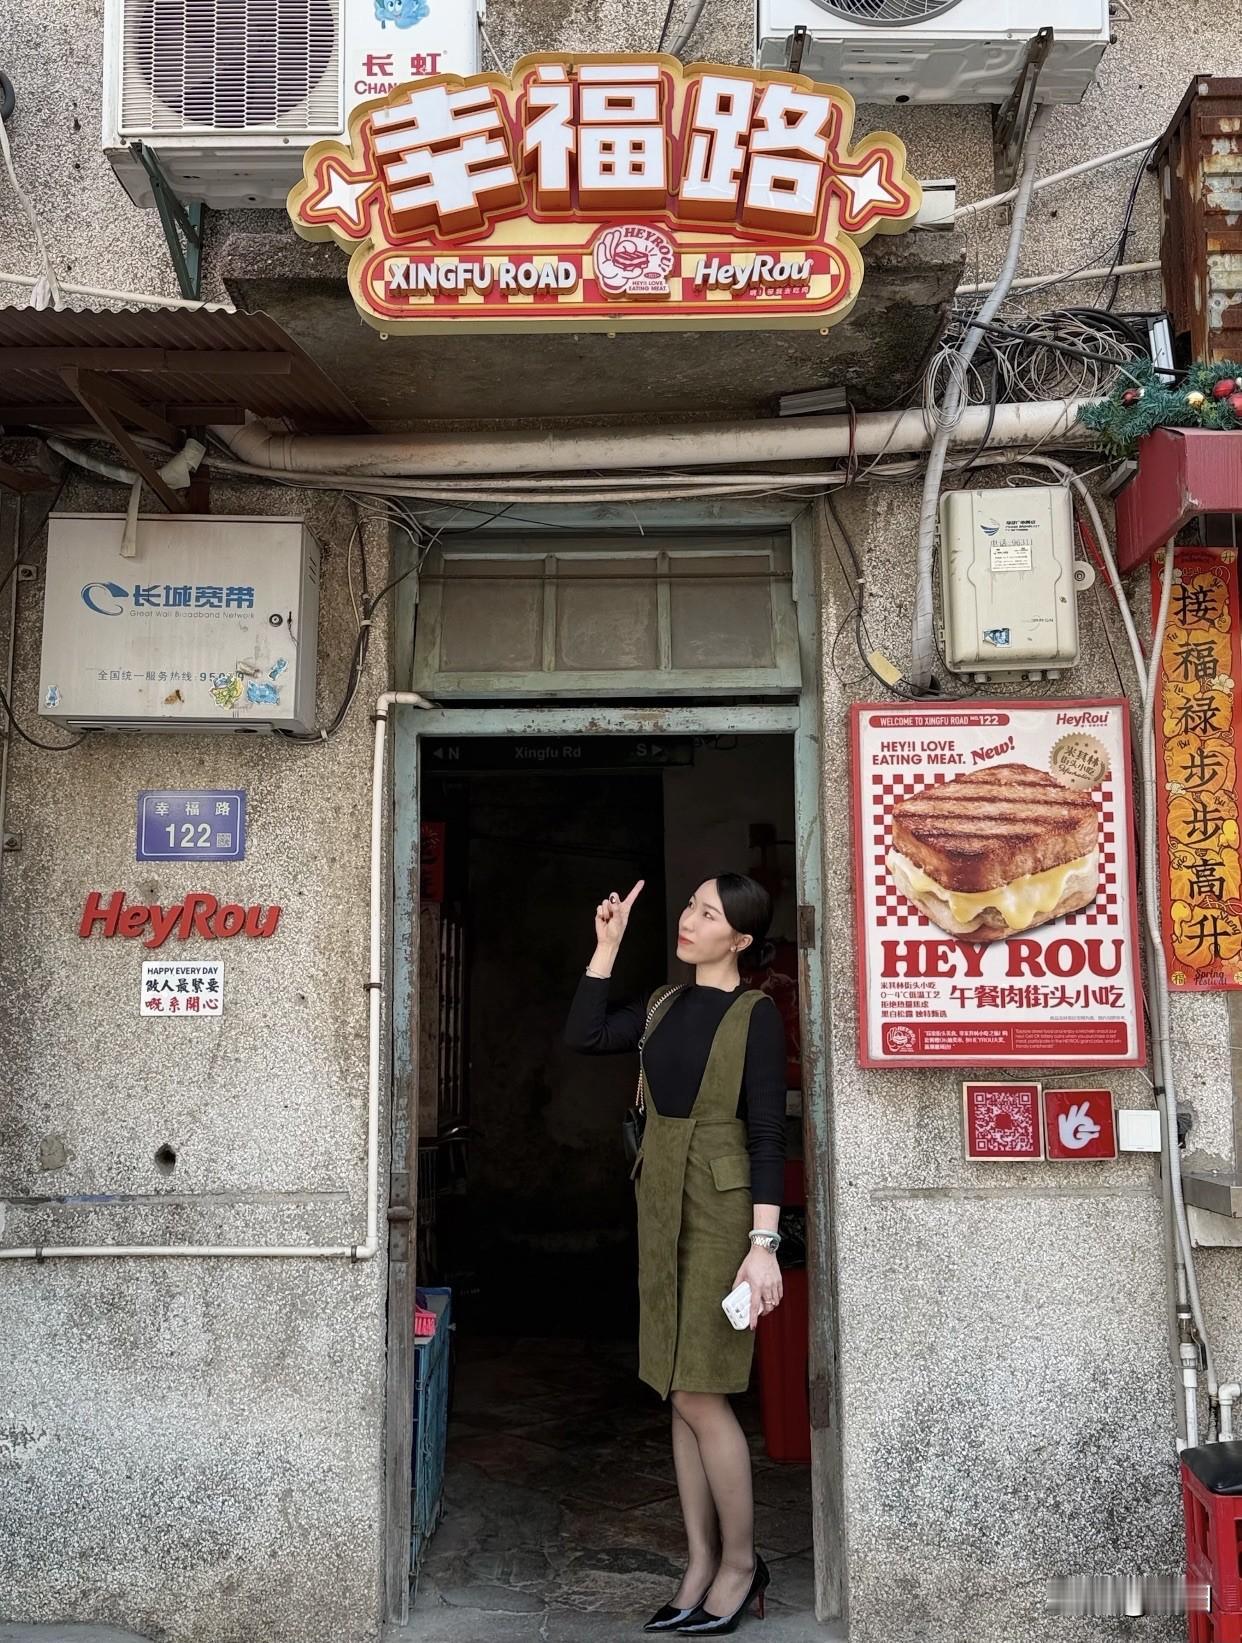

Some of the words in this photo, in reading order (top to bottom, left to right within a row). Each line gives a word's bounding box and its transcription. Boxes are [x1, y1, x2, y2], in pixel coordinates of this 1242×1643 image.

[362, 53, 441, 76] 长虹
[367, 63, 834, 228] 幸福路
[389, 262, 494, 294] XINGFU
[500, 262, 579, 294] ROAD
[694, 255, 814, 291] HeyRou
[133, 585, 255, 609] 长城宽带
[155, 610, 171, 618] Wall
[174, 611, 220, 619] Broadband
[222, 611, 255, 619] Network
[98, 669, 193, 682] 全国统一服务热线
[880, 717, 913, 727] WELCOME
[915, 717, 923, 726] TO
[924, 716, 949, 726] XINGFU
[950, 716, 969, 725] ROAD
[1056, 711, 1109, 727] HeyRou
[514, 745, 559, 761] Xingfu
[562, 745, 582, 759] Rd
[636, 743, 648, 757] S
[920, 740, 956, 752] LOVE
[970, 735, 1016, 766] New!
[872, 754, 923, 766] EATING
[926, 753, 966, 765] MEAT.
[155, 801, 231, 817] 幸福路
[165, 823, 212, 848] 122
[79, 891, 281, 949] HeyRou
[880, 939, 992, 978] HEY
[1005, 938, 1125, 978] ROU
[147, 966, 174, 975] HAPPY
[175, 966, 201, 975] EVERY
[202, 966, 219, 975] DAY
[949, 984, 1126, 1009] 午餐肉街头小吃
